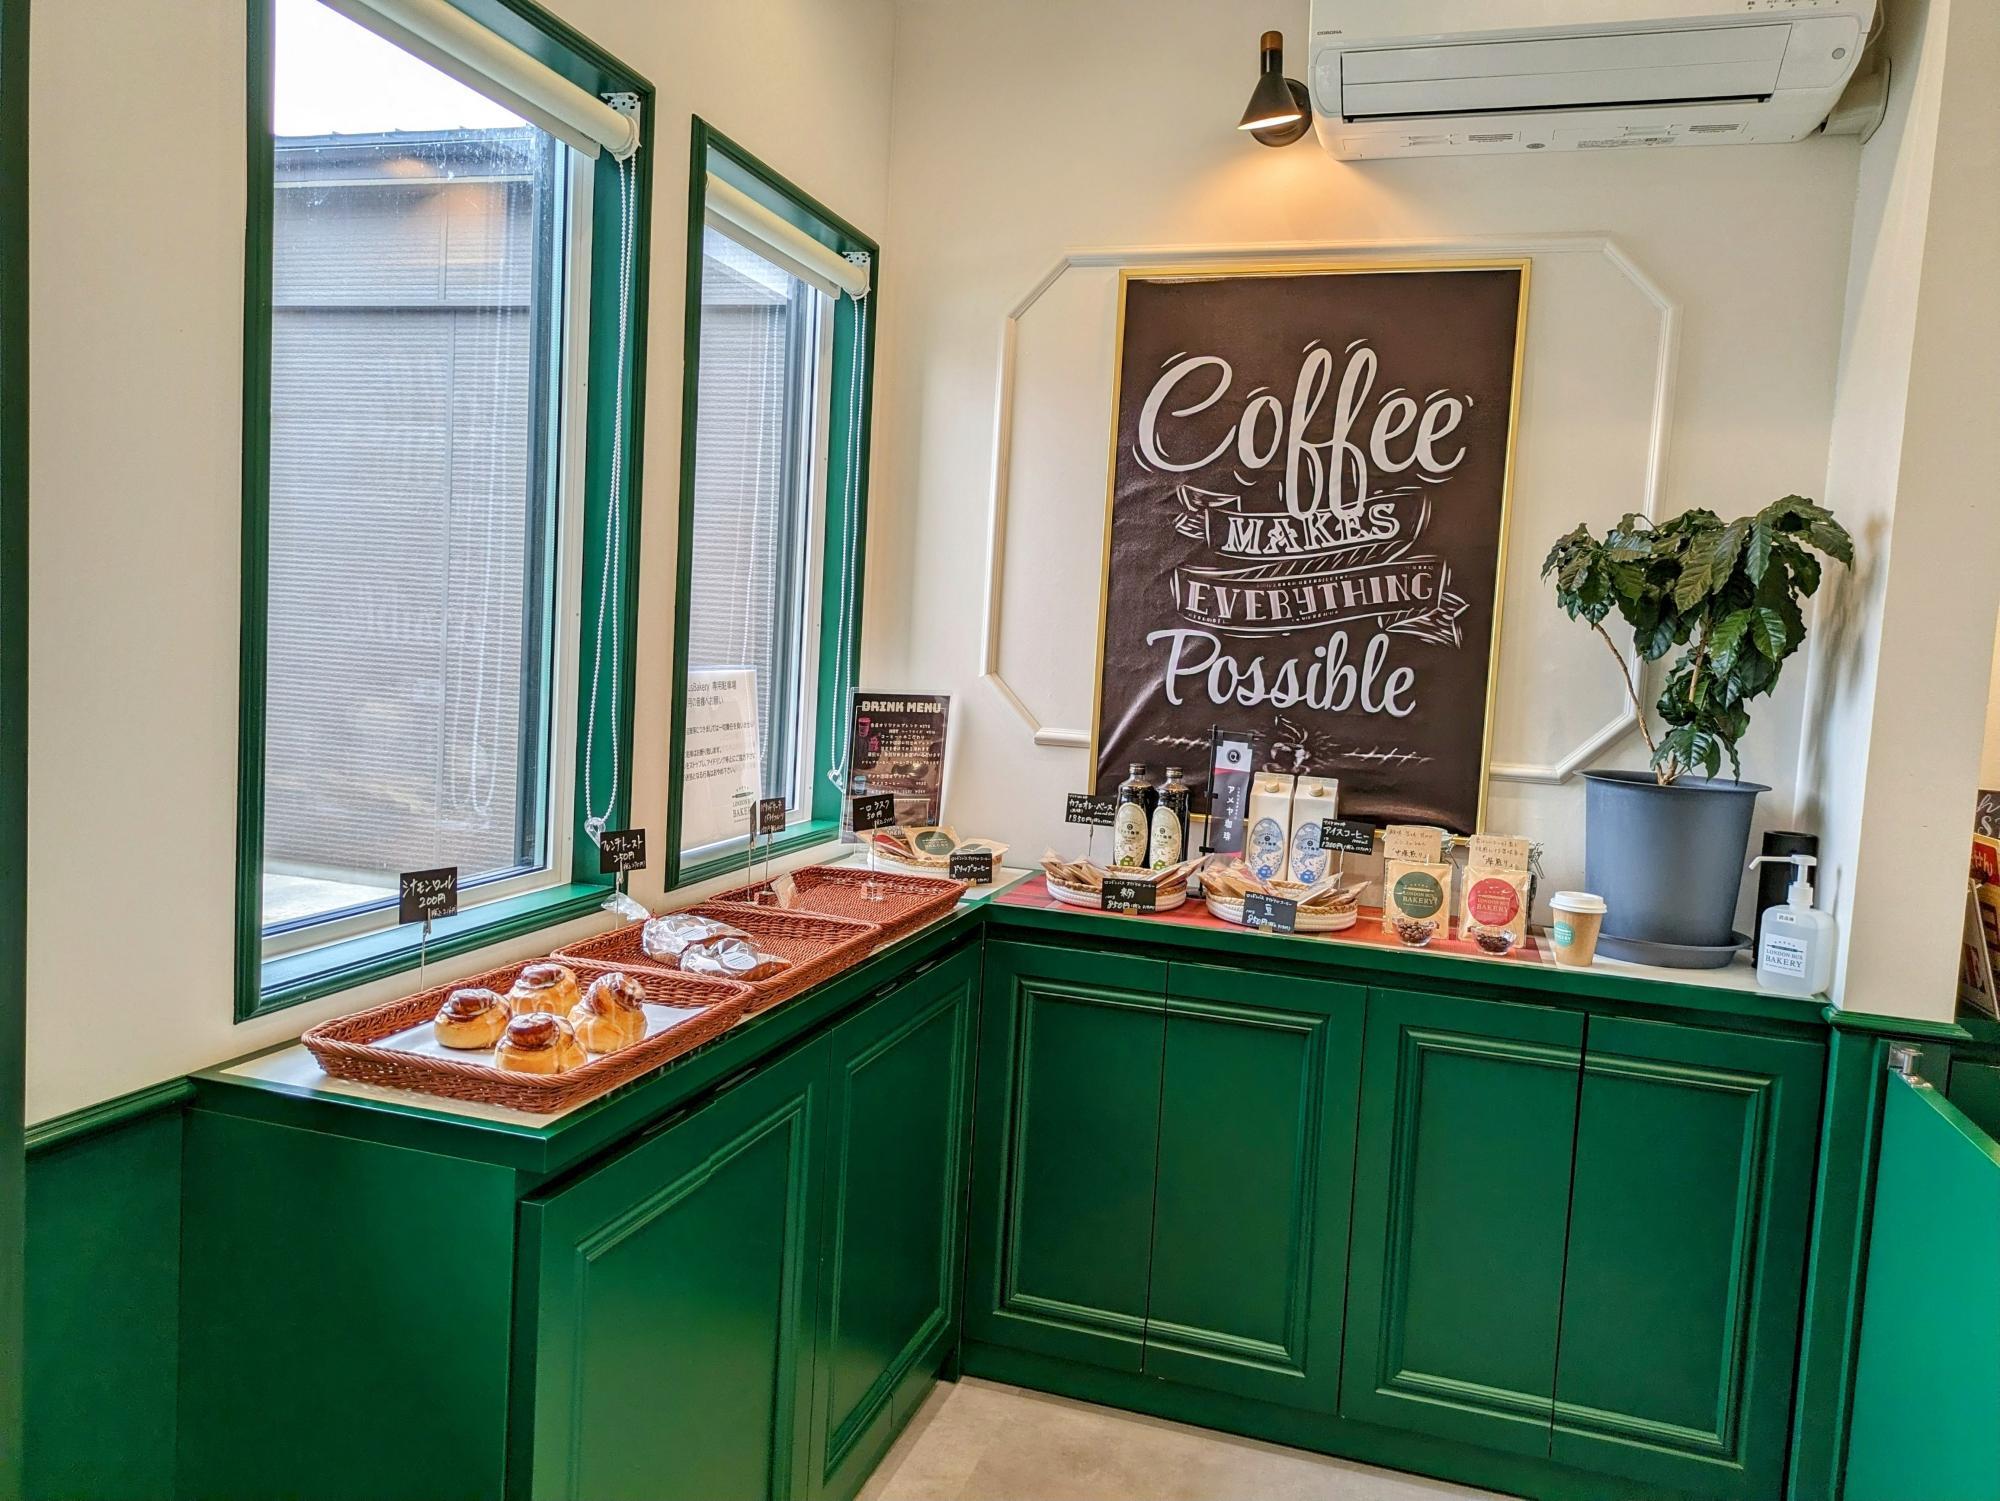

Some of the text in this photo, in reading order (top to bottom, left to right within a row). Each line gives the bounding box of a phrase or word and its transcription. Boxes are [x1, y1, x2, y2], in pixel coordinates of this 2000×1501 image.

[1139, 347, 1466, 519] Coffee
[1221, 503, 1400, 555] MAKES
[1186, 571, 1434, 622] EVERYTHING
[1146, 629, 1416, 717] Possible
[861, 700, 941, 713] DRINK MENU
[1323, 826, 1370, 840] アイスコーヒー
[1120, 887, 1136, 899] 粉
[1402, 895, 1434, 905] BAKERY
[418, 893, 447, 908] 200円
[1476, 902, 1509, 912] BAKERY
[1264, 903, 1275, 917] 豆
[1766, 948, 1790, 958] LONDON
[1765, 953, 1803, 968] BAKERY
